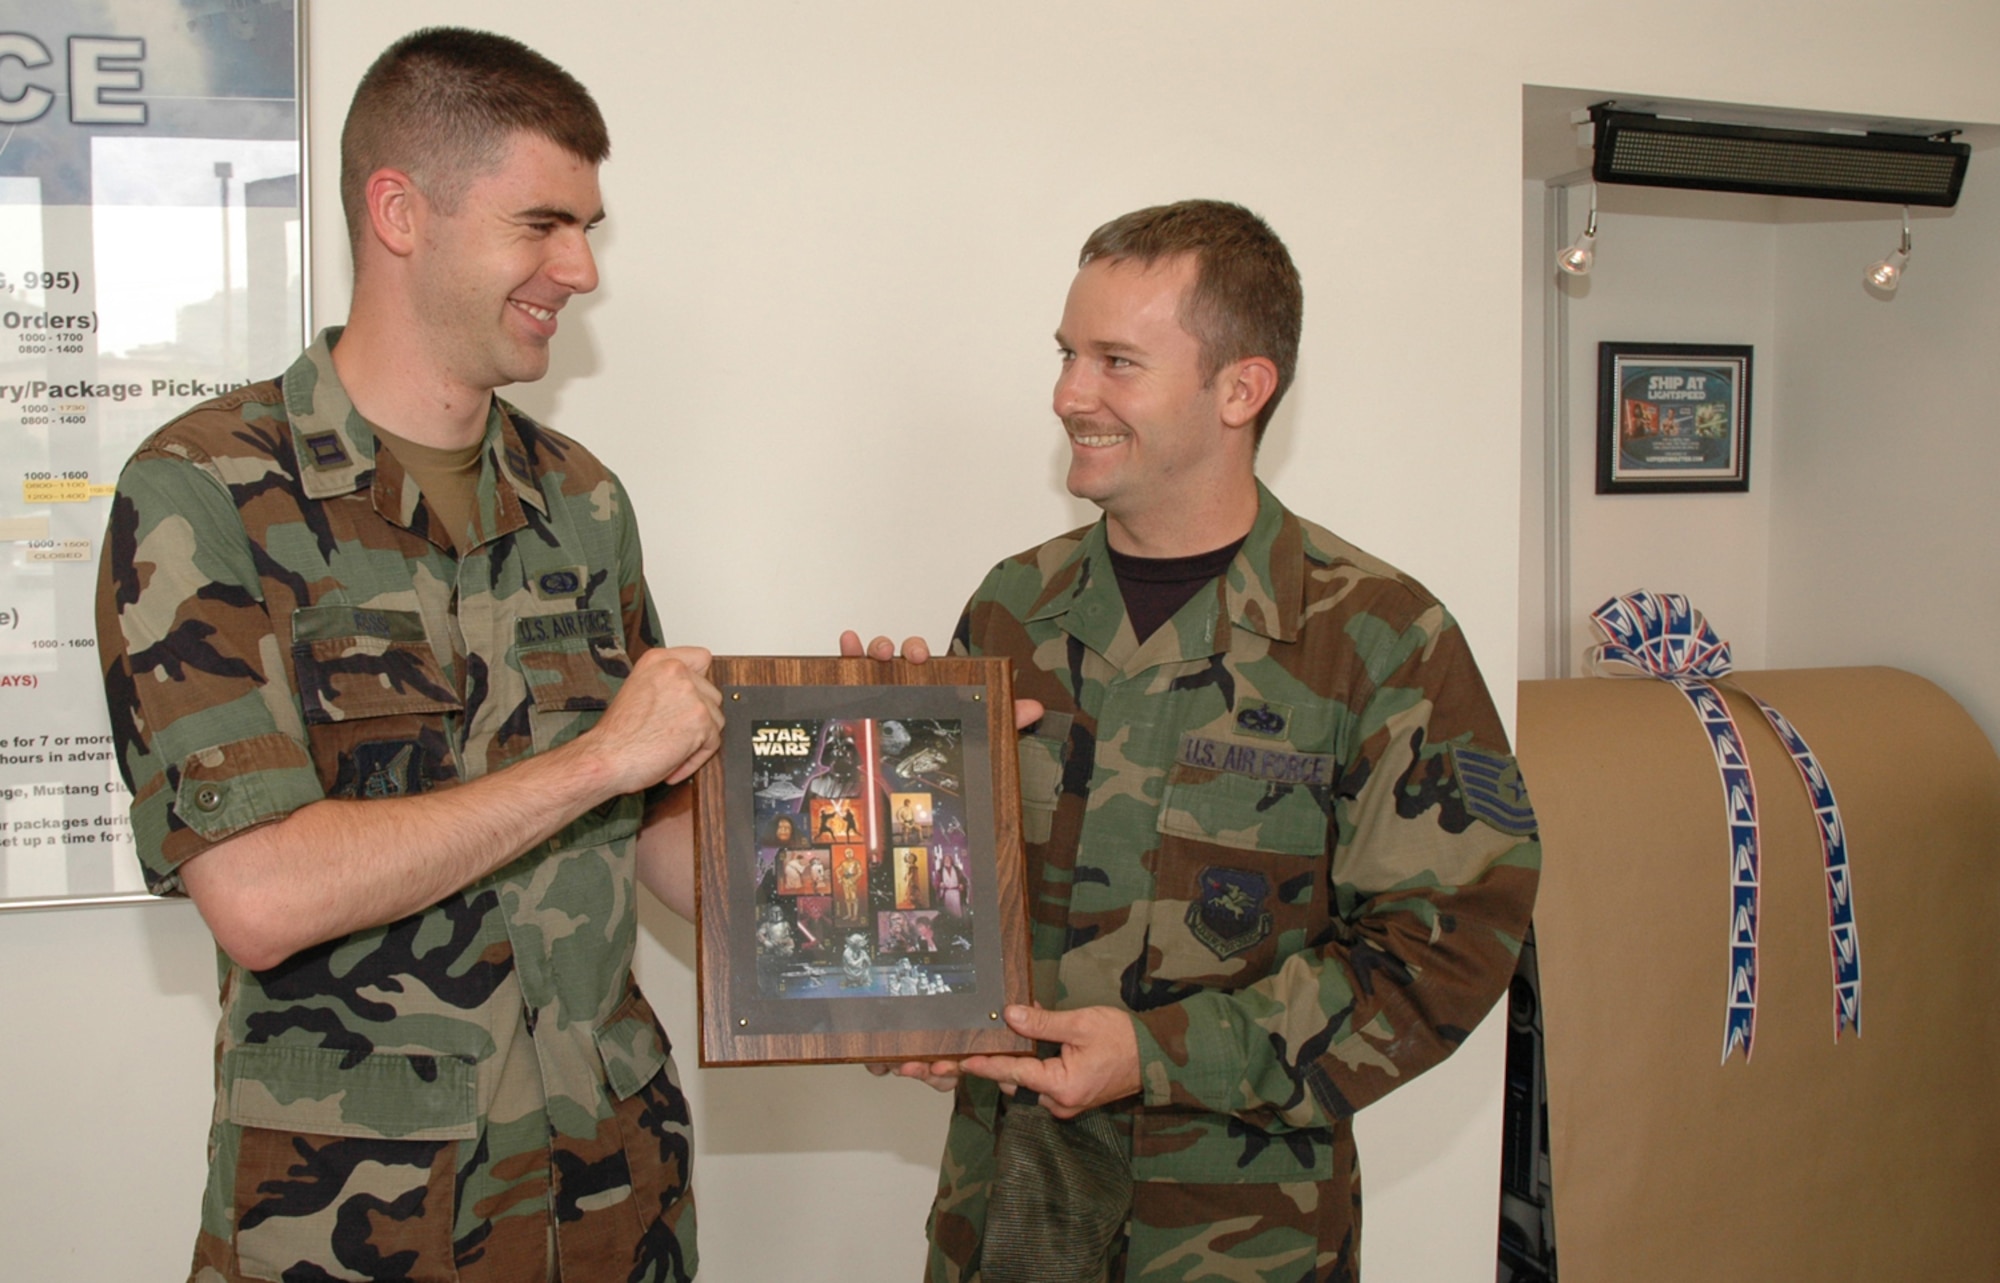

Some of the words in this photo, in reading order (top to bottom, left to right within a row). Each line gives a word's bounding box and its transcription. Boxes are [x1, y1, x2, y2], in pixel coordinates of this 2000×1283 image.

[23, 271, 79, 294] 995)
[3, 311, 98, 333] Orders)
[19, 333, 46, 342] 1000
[56, 333, 83, 342] 1700
[18, 345, 46, 354] 0800
[56, 345, 83, 354] 1400
[151, 379, 251, 397] Pick-u
[1648, 376, 1684, 390] SHIP
[1686, 376, 1707, 390] AT
[1648, 390, 1706, 400] LIGHTSPEED
[21, 405, 48, 413] 1000
[21, 417, 48, 425] 0800
[60, 416, 86, 424] 1400
[24, 472, 51, 480] 1000
[62, 471, 89, 480] 1600
[28, 540, 54, 549] 1000
[34, 552, 82, 560] CLOSED
[519, 619, 549, 643] U.S.
[552, 615, 578, 639] AIR
[32, 640, 58, 648] 1000
[69, 639, 95, 648] 1600
[13, 736, 35, 747] for
[40, 735, 49, 746] 7
[55, 737, 70, 745] or
[75, 736, 113, 745] more
[752, 728, 810, 742] STAR
[752, 742, 811, 756] WARS
[0, 754, 44, 764] hours
[49, 751, 63, 762] in
[1185, 739, 1215, 768] U.S.
[1223, 745, 1256, 773] AIR
[1262, 750, 1327, 784] FORCE
[33, 785, 99, 797] Mustang
[14, 818, 89, 832] packages
[0, 836, 18, 847] et
[23, 837, 42, 848] up
[47, 836, 56, 845] a
[62, 833, 96, 844] time
[101, 831, 122, 842] for
